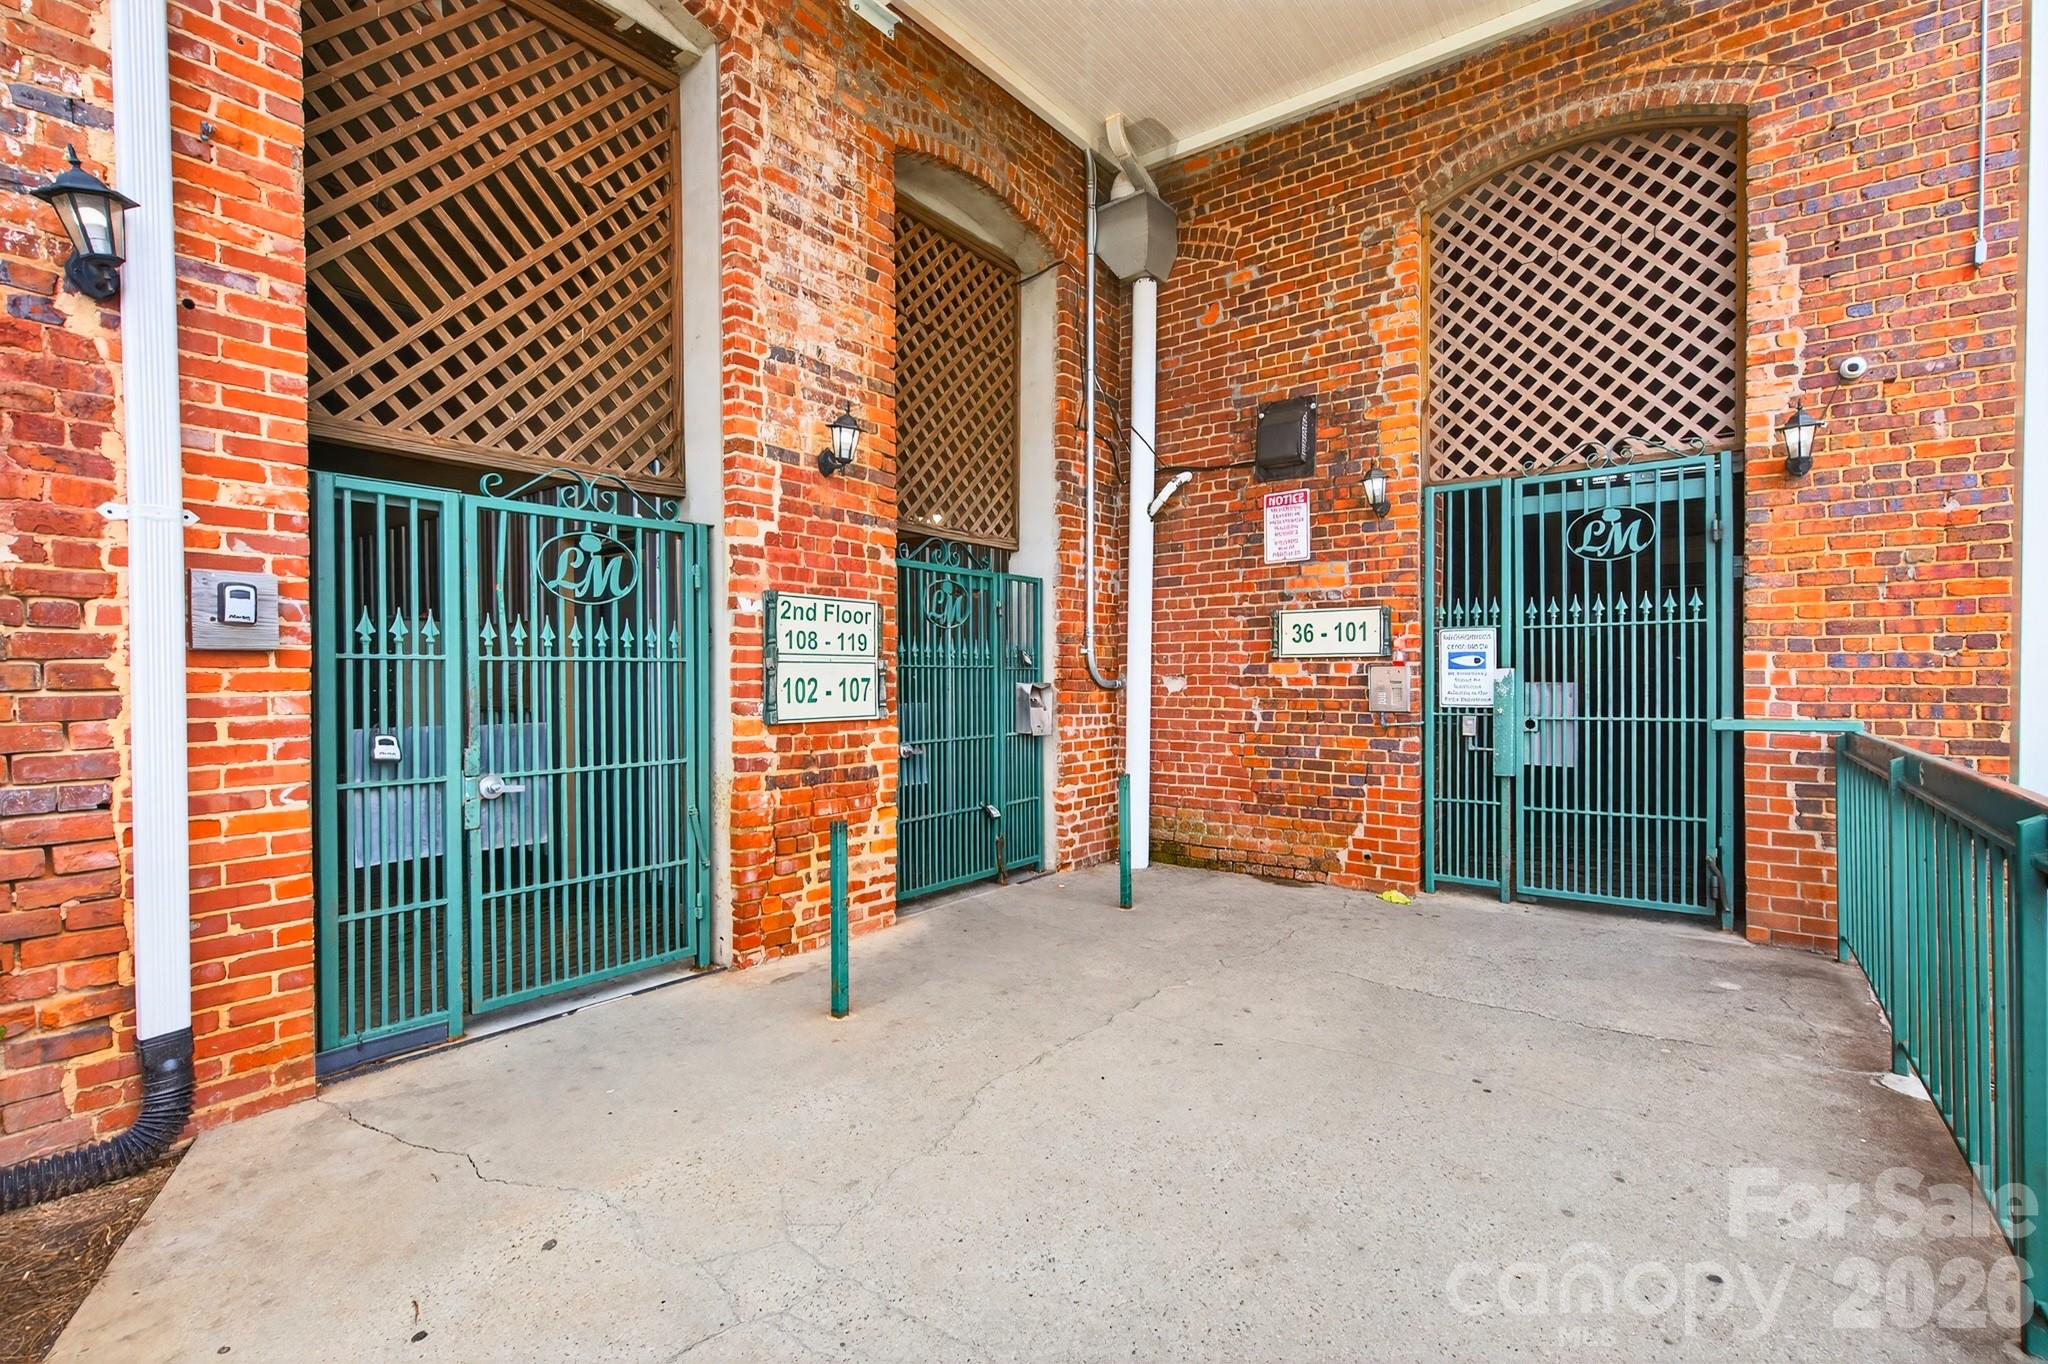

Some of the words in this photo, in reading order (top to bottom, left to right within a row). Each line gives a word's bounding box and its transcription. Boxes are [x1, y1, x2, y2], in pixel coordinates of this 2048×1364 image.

[1268, 492, 1305, 506] NOTICE
[780, 600, 817, 621] 2nd
[824, 603, 872, 625] Floor
[785, 630, 818, 650] 108
[837, 632, 868, 651] 119
[1291, 623, 1314, 643] 36
[1334, 621, 1367, 642] 101
[783, 677, 818, 704] 102
[838, 677, 871, 702] 107
